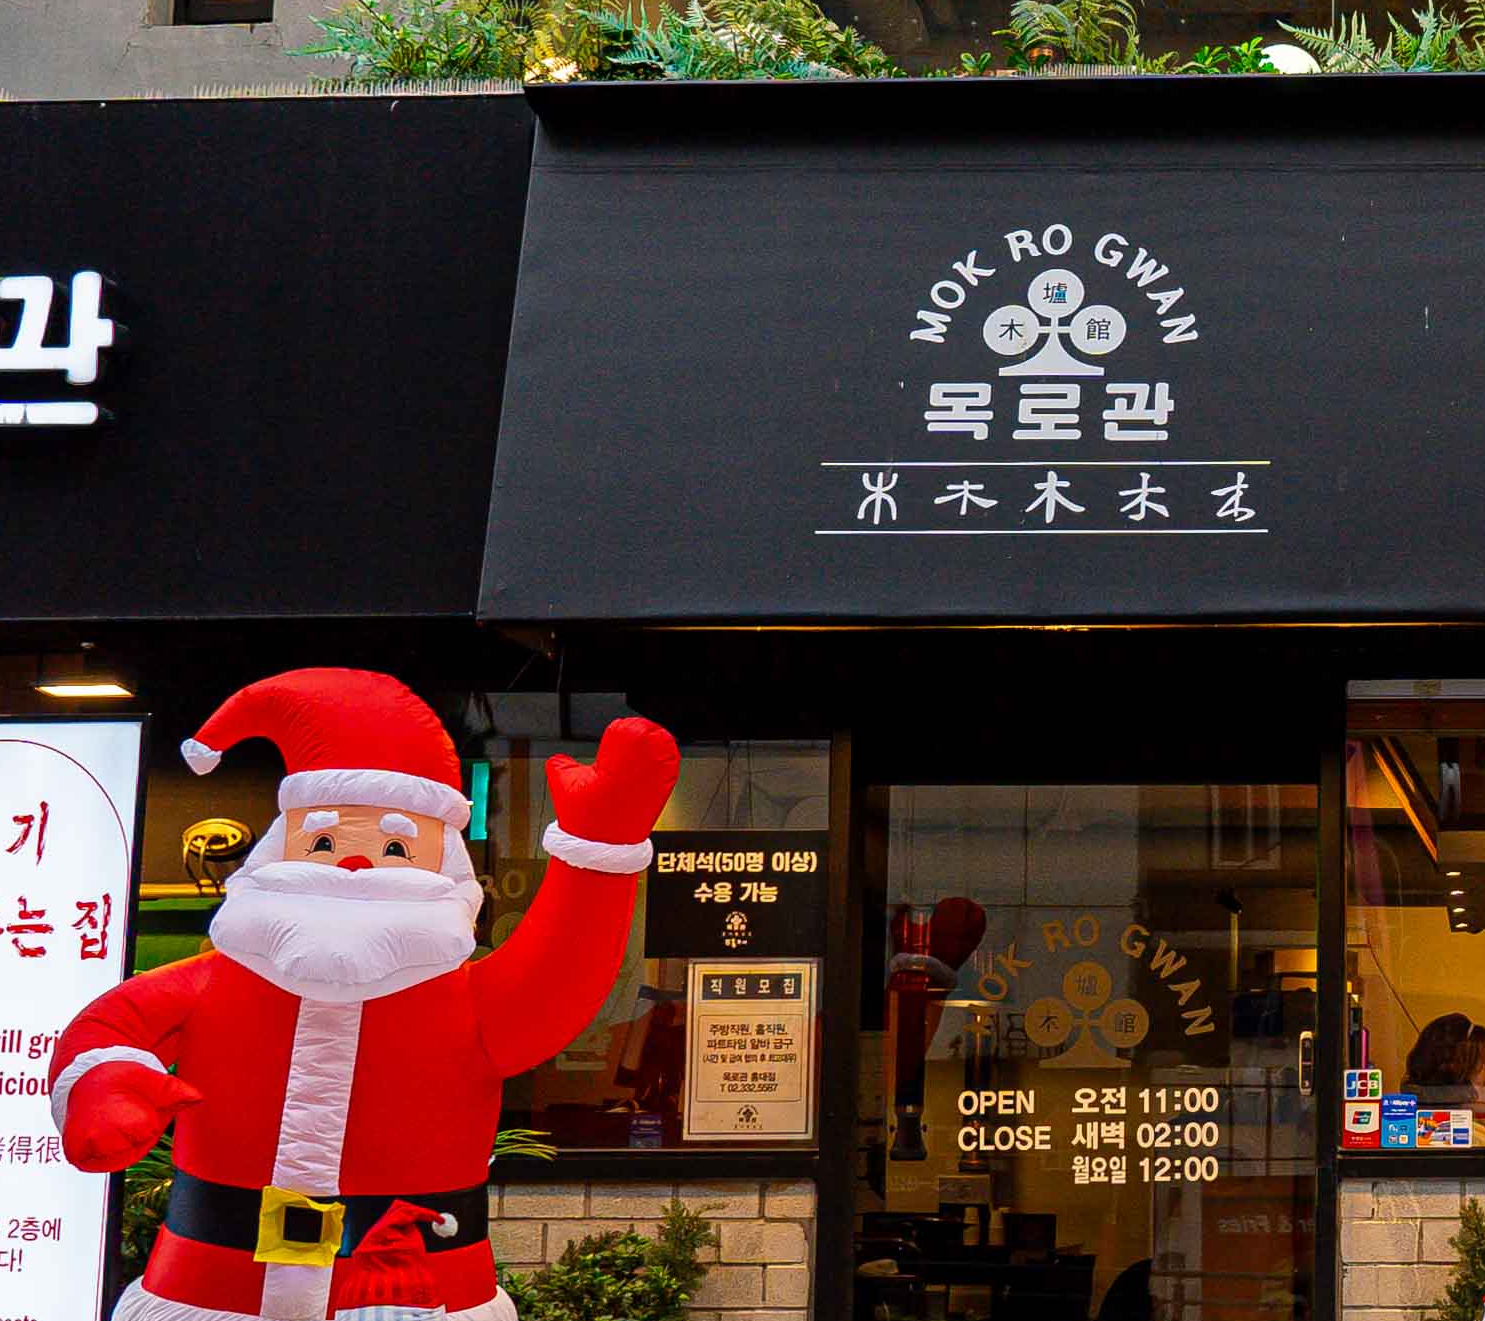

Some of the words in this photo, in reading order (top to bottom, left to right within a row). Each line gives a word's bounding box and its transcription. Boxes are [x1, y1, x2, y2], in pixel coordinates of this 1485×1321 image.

[909, 250, 997, 345] MOK
[1004, 223, 1073, 263] RO
[1093, 232, 1199, 345] GWAN
[923, 381, 1175, 442] 목로관
[657, 850, 765, 875] 단체석(50명
[771, 850, 819, 875] 이상)
[693, 881, 733, 904] 수용
[740, 881, 779, 904] 가능
[70, 891, 113, 961] 집
[710, 977, 796, 996] 직원모집
[1346, 1072, 1380, 1098] JCB
[958, 1090, 1036, 1115] OPEN
[1071, 1087, 1127, 1116] 오전
[1138, 1087, 1219, 1114] 11:00
[958, 1125, 1052, 1152] CLOSE
[1071, 1121, 1126, 1151] 새벽
[1136, 1122, 1219, 1149] 02:00
[1071, 1156, 1127, 1186] 월요일
[1138, 1156, 1219, 1183] 12:00
[6, 1217, 62, 1242] 2층에
